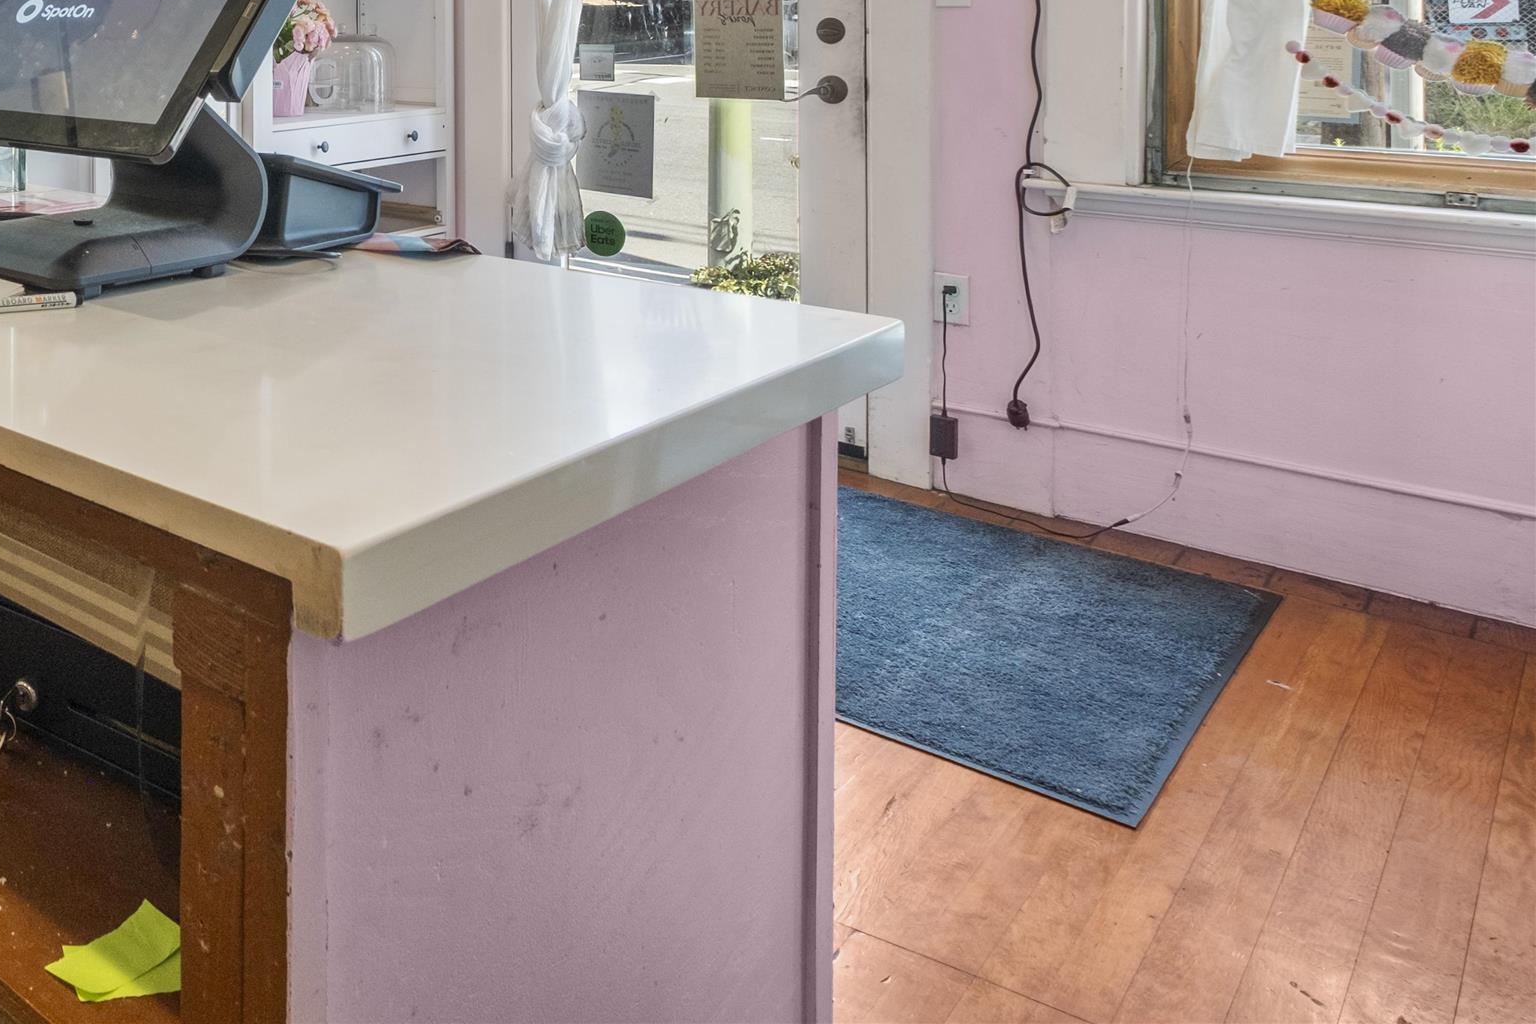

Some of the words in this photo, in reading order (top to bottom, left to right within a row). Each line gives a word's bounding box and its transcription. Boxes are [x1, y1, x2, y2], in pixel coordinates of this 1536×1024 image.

[41, 4, 95, 21] SpotOn
[590, 224, 614, 235] Uber
[590, 234, 616, 246] Eats
[35, 294, 67, 304] MARKER
